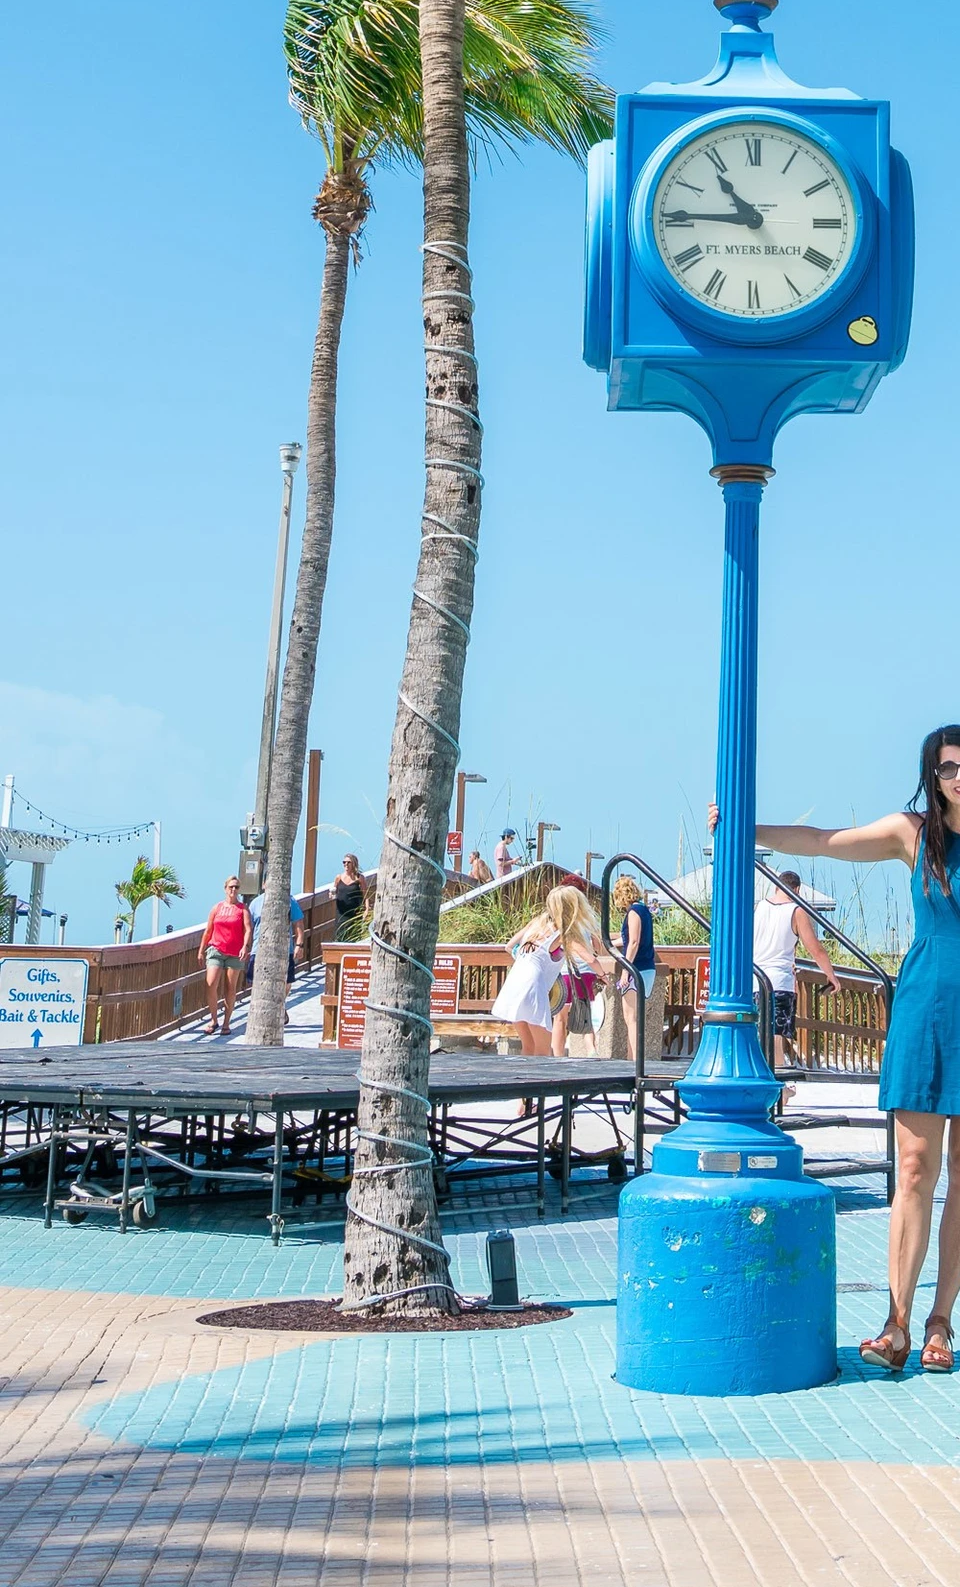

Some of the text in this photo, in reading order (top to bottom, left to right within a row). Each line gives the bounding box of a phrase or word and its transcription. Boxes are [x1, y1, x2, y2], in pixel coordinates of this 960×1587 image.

[704, 146, 729, 176] XI
[745, 138, 762, 166] XII
[781, 149, 799, 175] I
[675, 176, 705, 198] X
[803, 178, 832, 197] II
[812, 218, 842, 229] III
[705, 245, 801, 256] FT. MYERS BEACH
[703, 269, 728, 300] VII
[747, 280, 761, 309] VI
[783, 273, 802, 300] V
[27, 968, 61, 985] Gifts,
[8, 988, 76, 1003] Souvenirs,
[0, 1008, 80, 1023] Bait & Tackle
